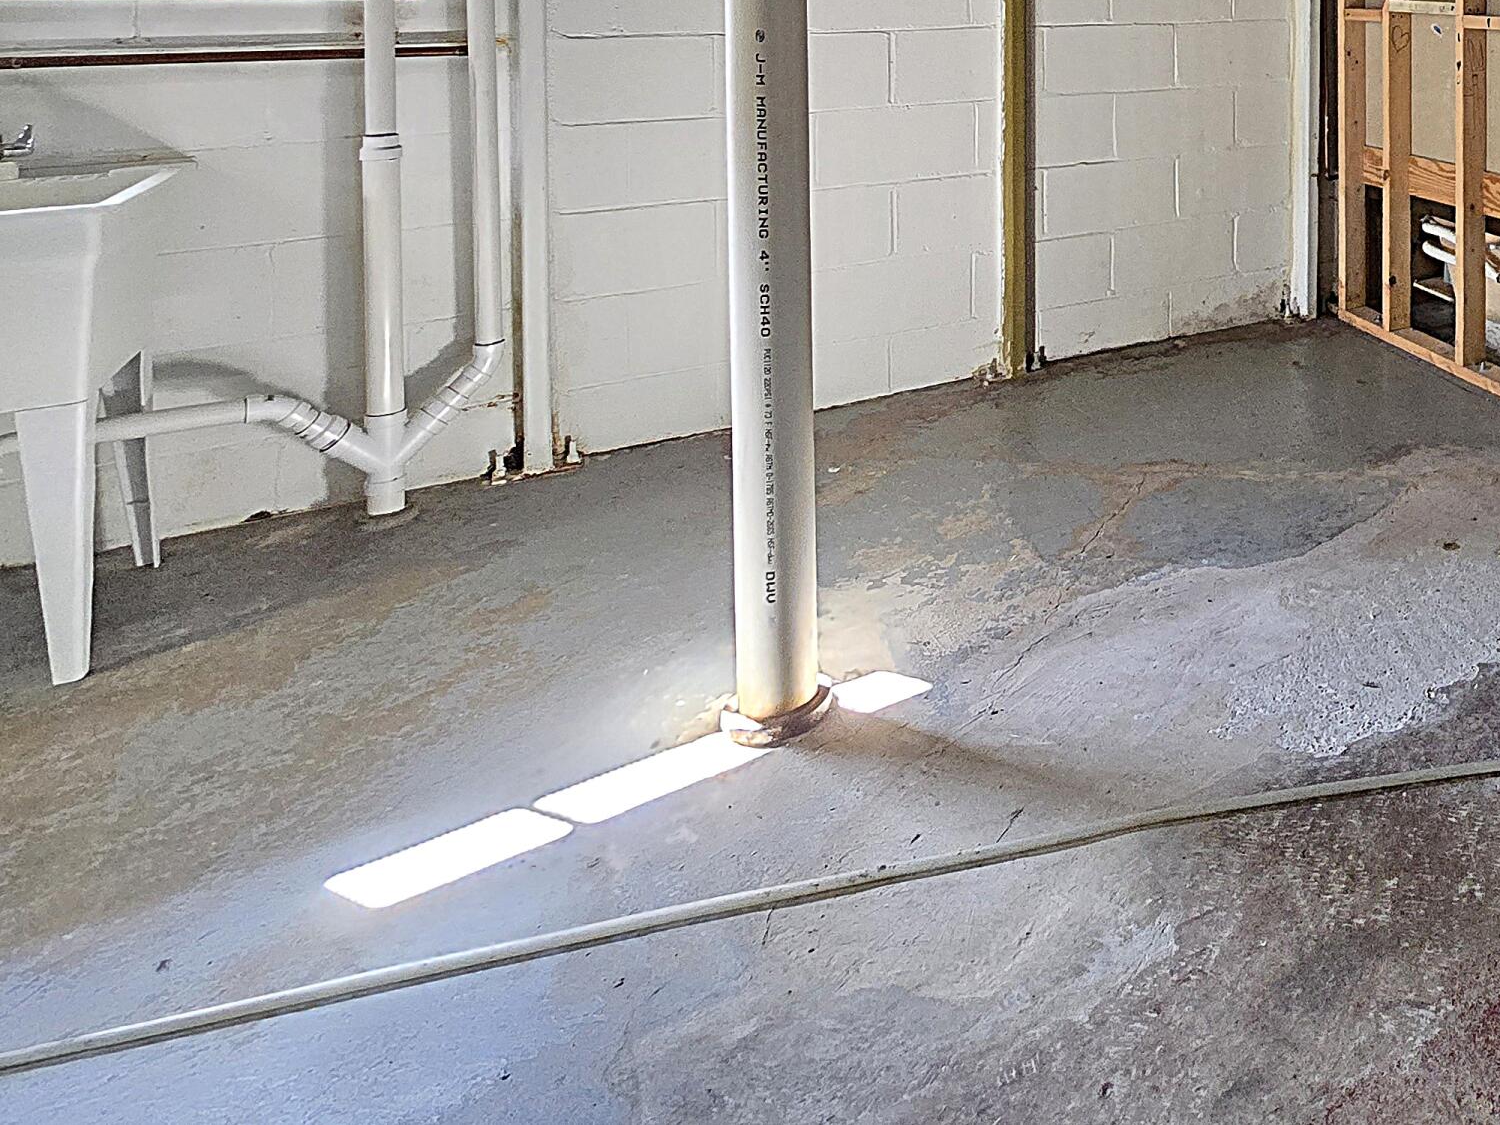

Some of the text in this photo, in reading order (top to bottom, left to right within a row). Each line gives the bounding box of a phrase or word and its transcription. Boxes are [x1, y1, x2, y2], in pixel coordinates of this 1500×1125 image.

[755, 53, 766, 86] J-M
[756, 96, 769, 239] MANUFACTURING
[759, 283, 771, 338] SCH40
